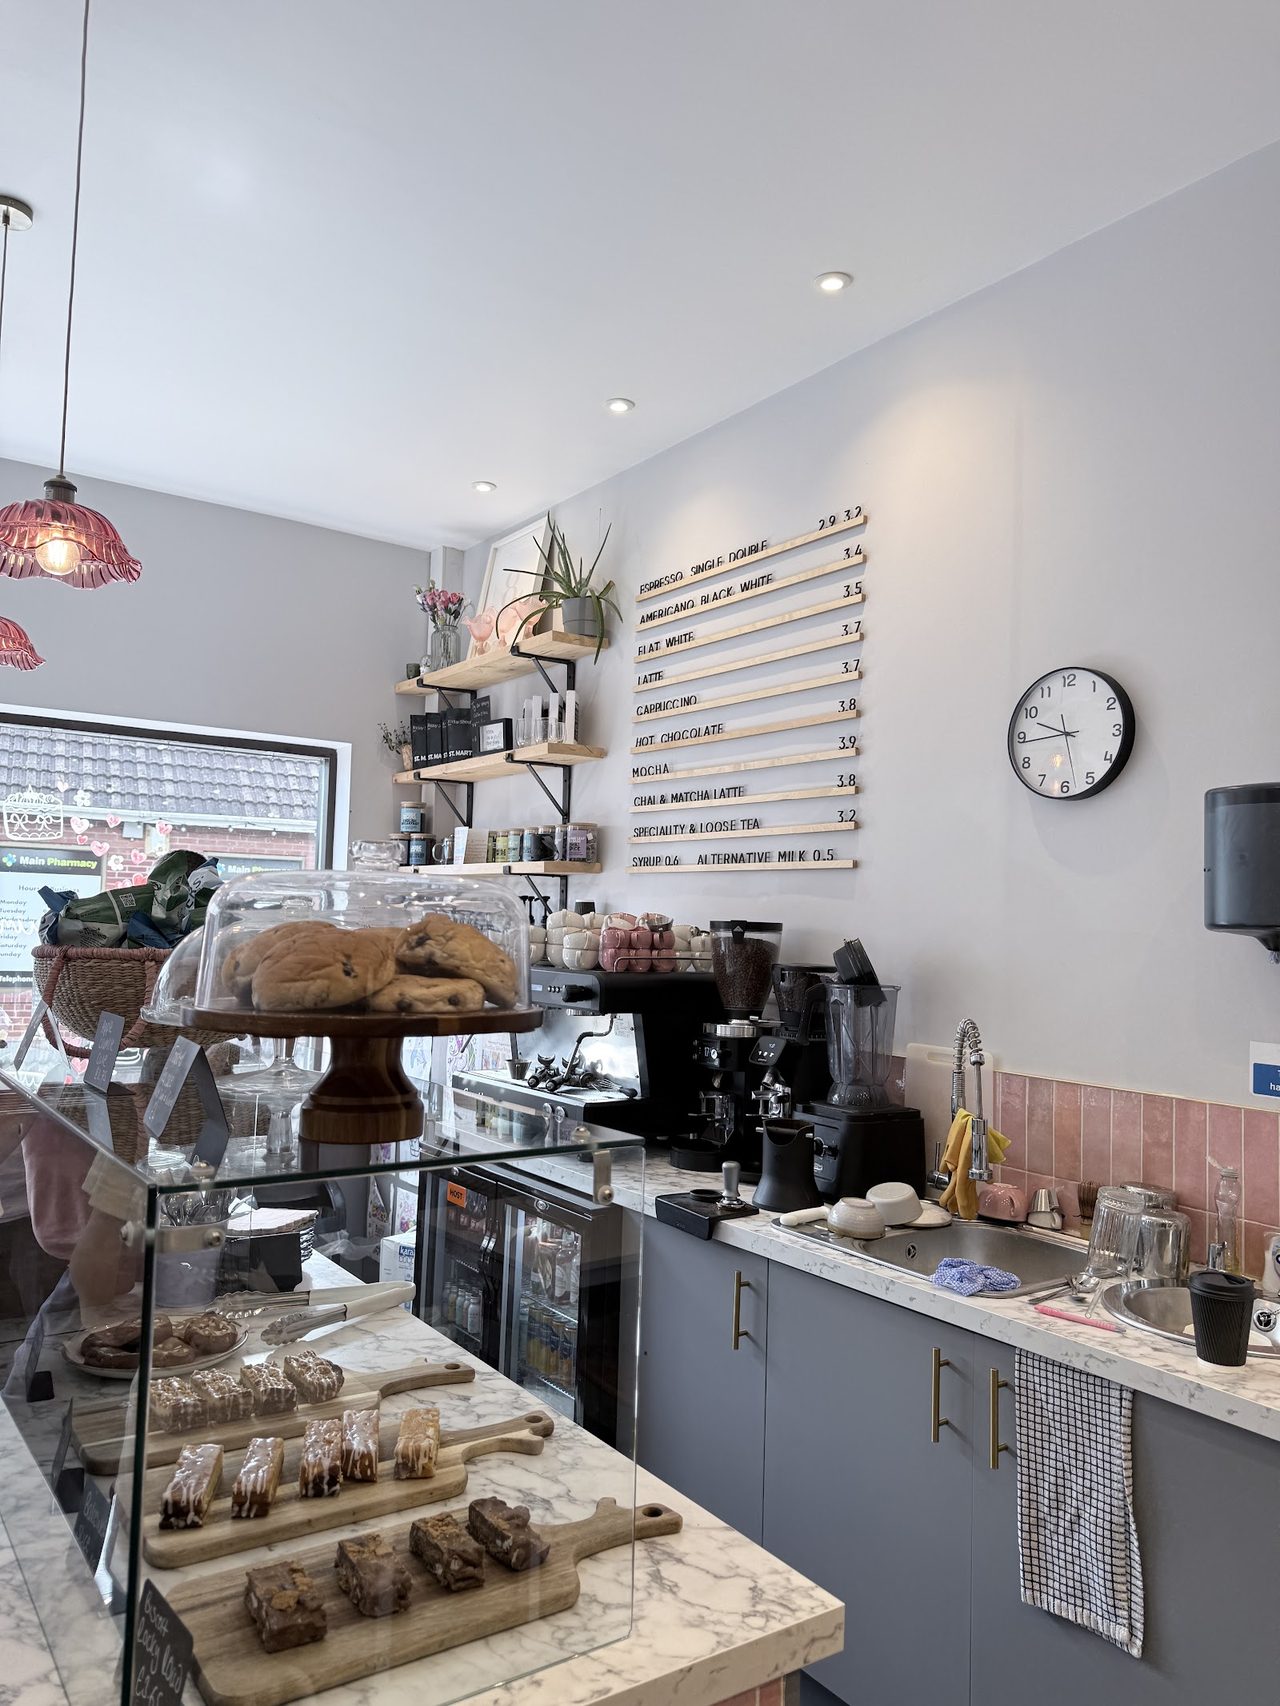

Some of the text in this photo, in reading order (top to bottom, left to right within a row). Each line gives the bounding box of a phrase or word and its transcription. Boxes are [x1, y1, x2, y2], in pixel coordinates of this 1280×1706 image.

[639, 505, 862, 595] ESPRESSO SINGLE DOUBLE 2.9 3.2
[639, 544, 863, 625] AMERICANO BLACK WHITE 3.4
[637, 581, 863, 656] FLAT WHITE 3.5
[637, 620, 862, 686] LATTE 3.7
[1062, 673, 1077, 688] 12
[1091, 680, 1097, 693] 1
[636, 658, 860, 717] CAPPUCCINO 3.7
[1040, 685, 1051, 698] 11
[1106, 697, 1117, 710] 2
[1024, 706, 1038, 719] 10
[635, 698, 857, 748] HOT CHOCOLATE 3.8
[1112, 723, 1122, 737] 3
[1017, 731, 1027, 743] 9
[632, 735, 857, 778] MOCHA 3.9
[1022, 757, 1031, 769] 8
[1104, 751, 1113, 763] 4
[1038, 774, 1046, 787] 7
[1085, 772, 1095, 784] 5
[633, 773, 856, 807] CHAI & MATCHA LATTE 3.8
[1060, 781, 1070, 793] 6
[633, 809, 856, 838] SPECIALITY & LOOSE TEA 3.2
[20, 856, 98, 869] Main Pharmacy
[632, 848, 834, 867] SYRUP 0.6 ALTERNATIVE MILK 0.5
[228, 865, 251, 873] Main
